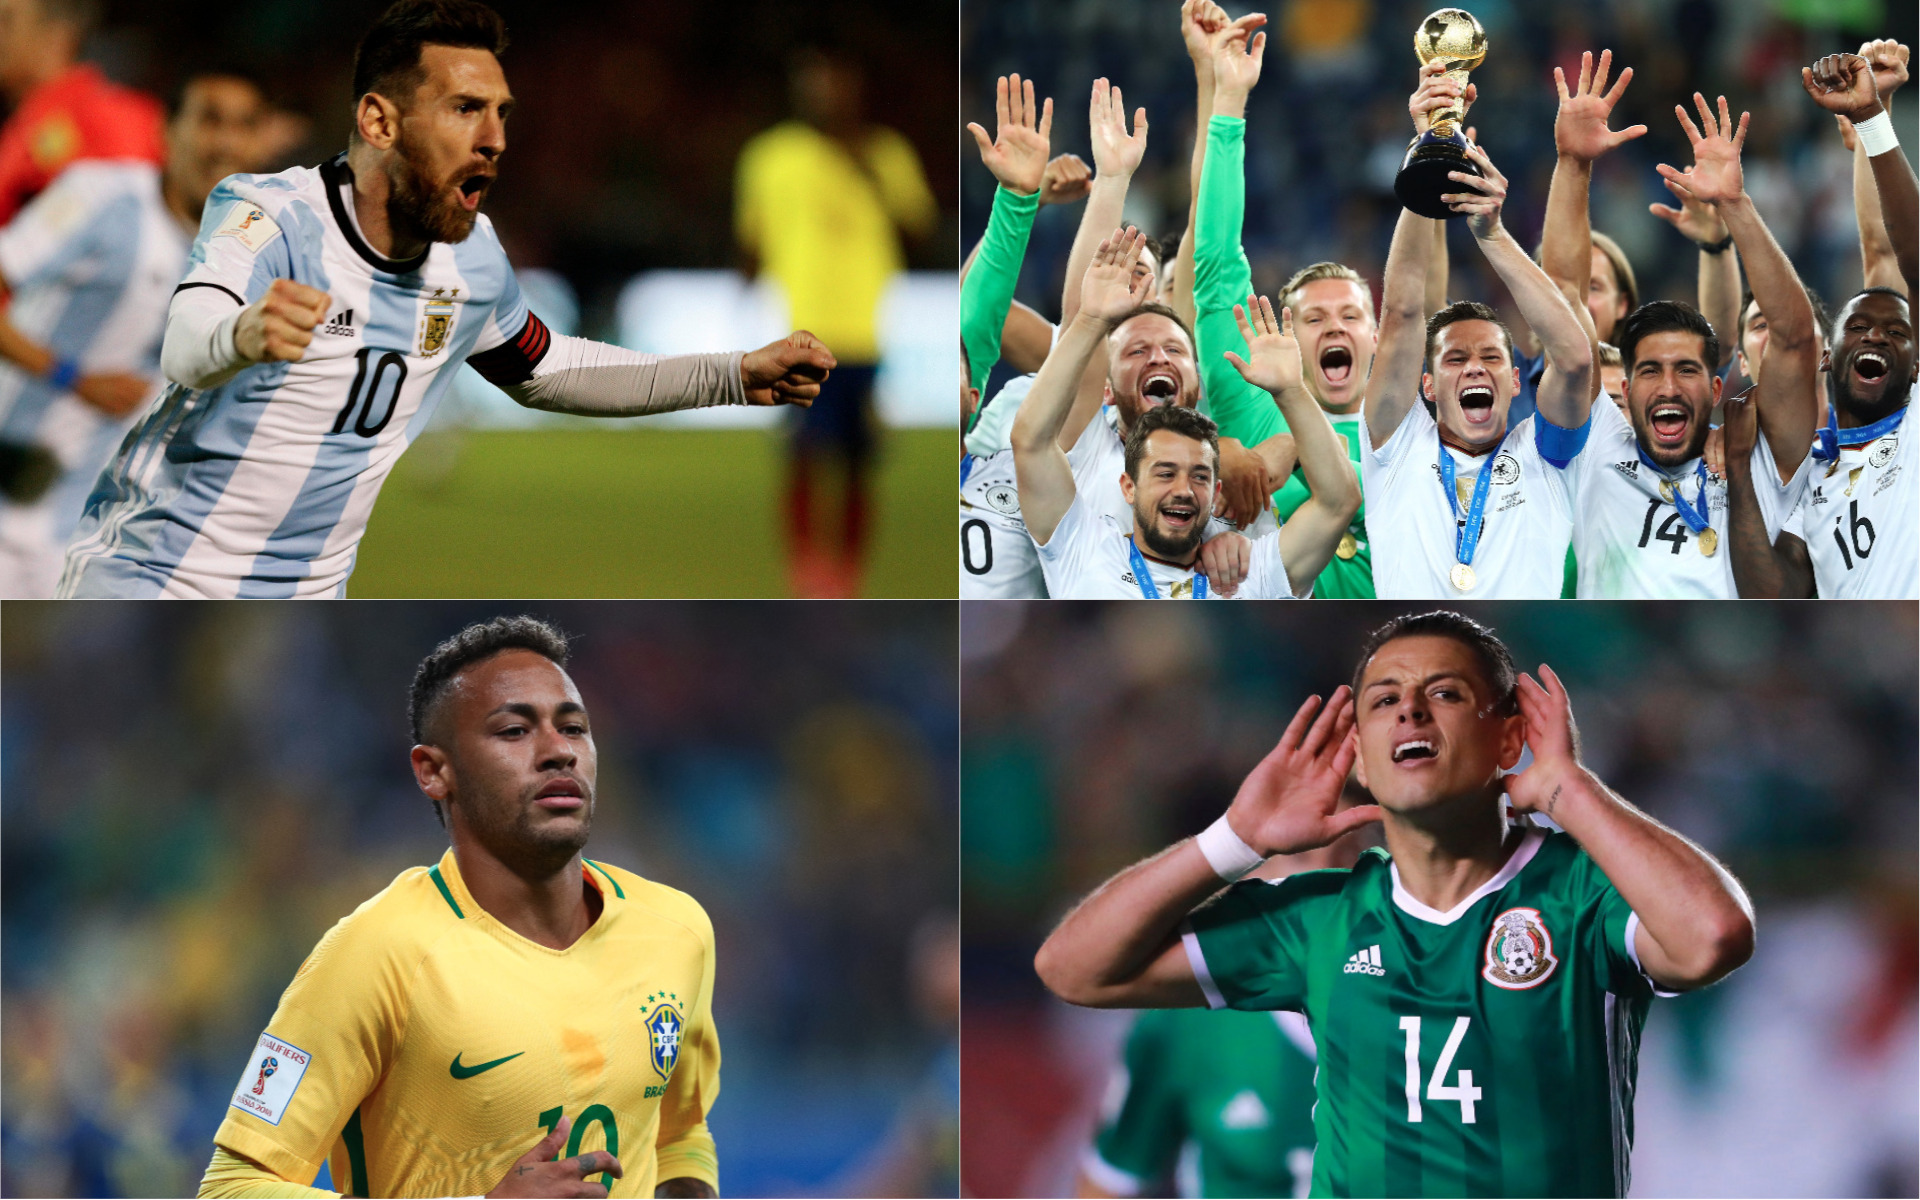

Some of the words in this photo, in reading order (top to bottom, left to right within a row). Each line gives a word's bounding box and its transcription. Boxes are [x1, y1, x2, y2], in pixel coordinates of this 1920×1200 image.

[325, 324, 354, 338] adidas
[331, 348, 408, 438] 10
[961, 518, 993, 576] 0
[1637, 498, 1689, 555] 14
[1833, 499, 1876, 571] 16
[1343, 960, 1386, 977] adidas
[661, 1035, 675, 1044] CBF
[1399, 1016, 1482, 1124] 14
